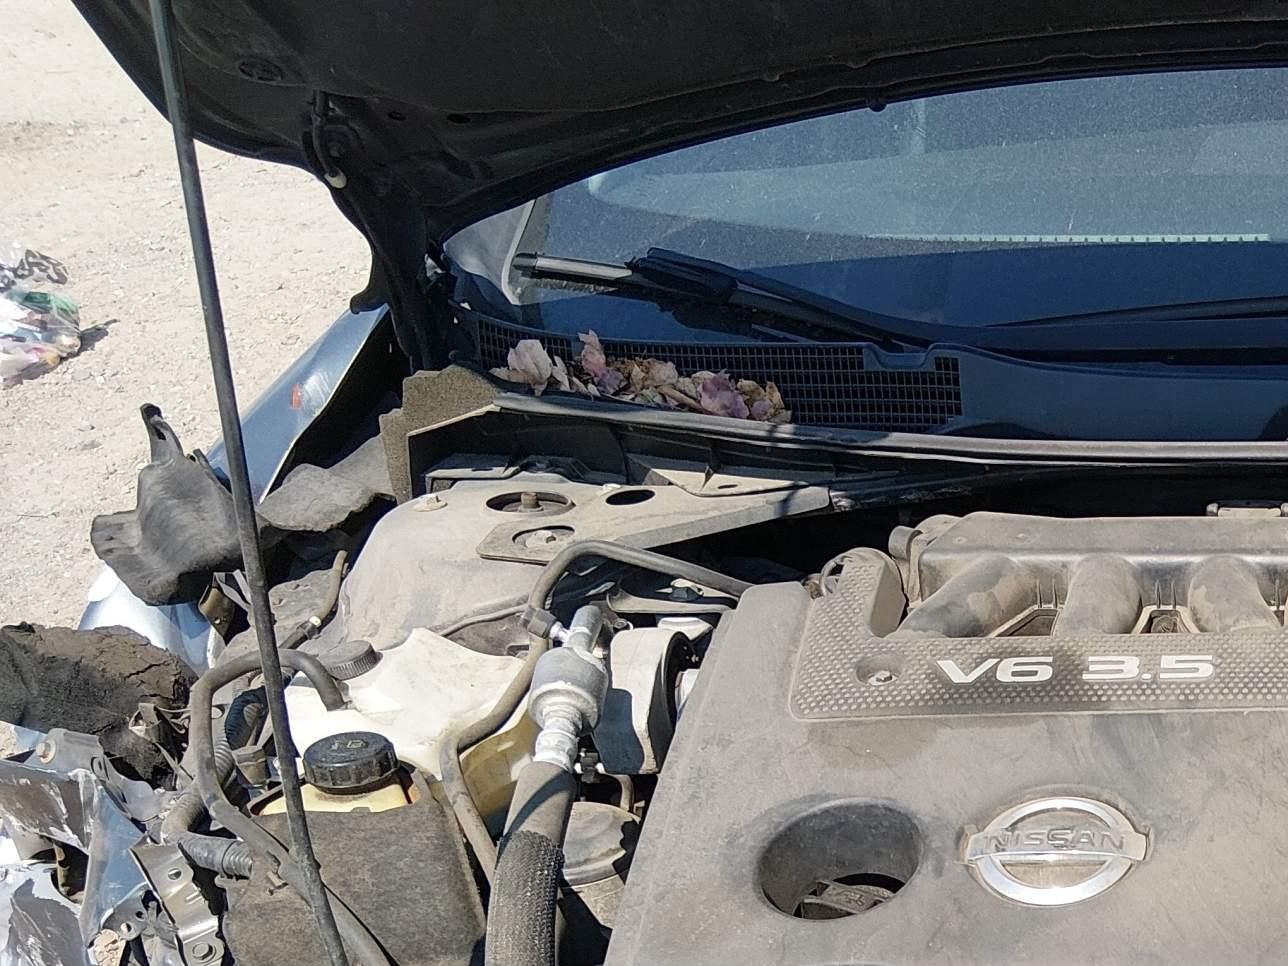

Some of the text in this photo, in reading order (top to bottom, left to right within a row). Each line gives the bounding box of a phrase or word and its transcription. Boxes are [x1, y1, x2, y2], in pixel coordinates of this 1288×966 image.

[936, 655, 1215, 684] V6 3.5
[985, 827, 1124, 851] NISSAN
